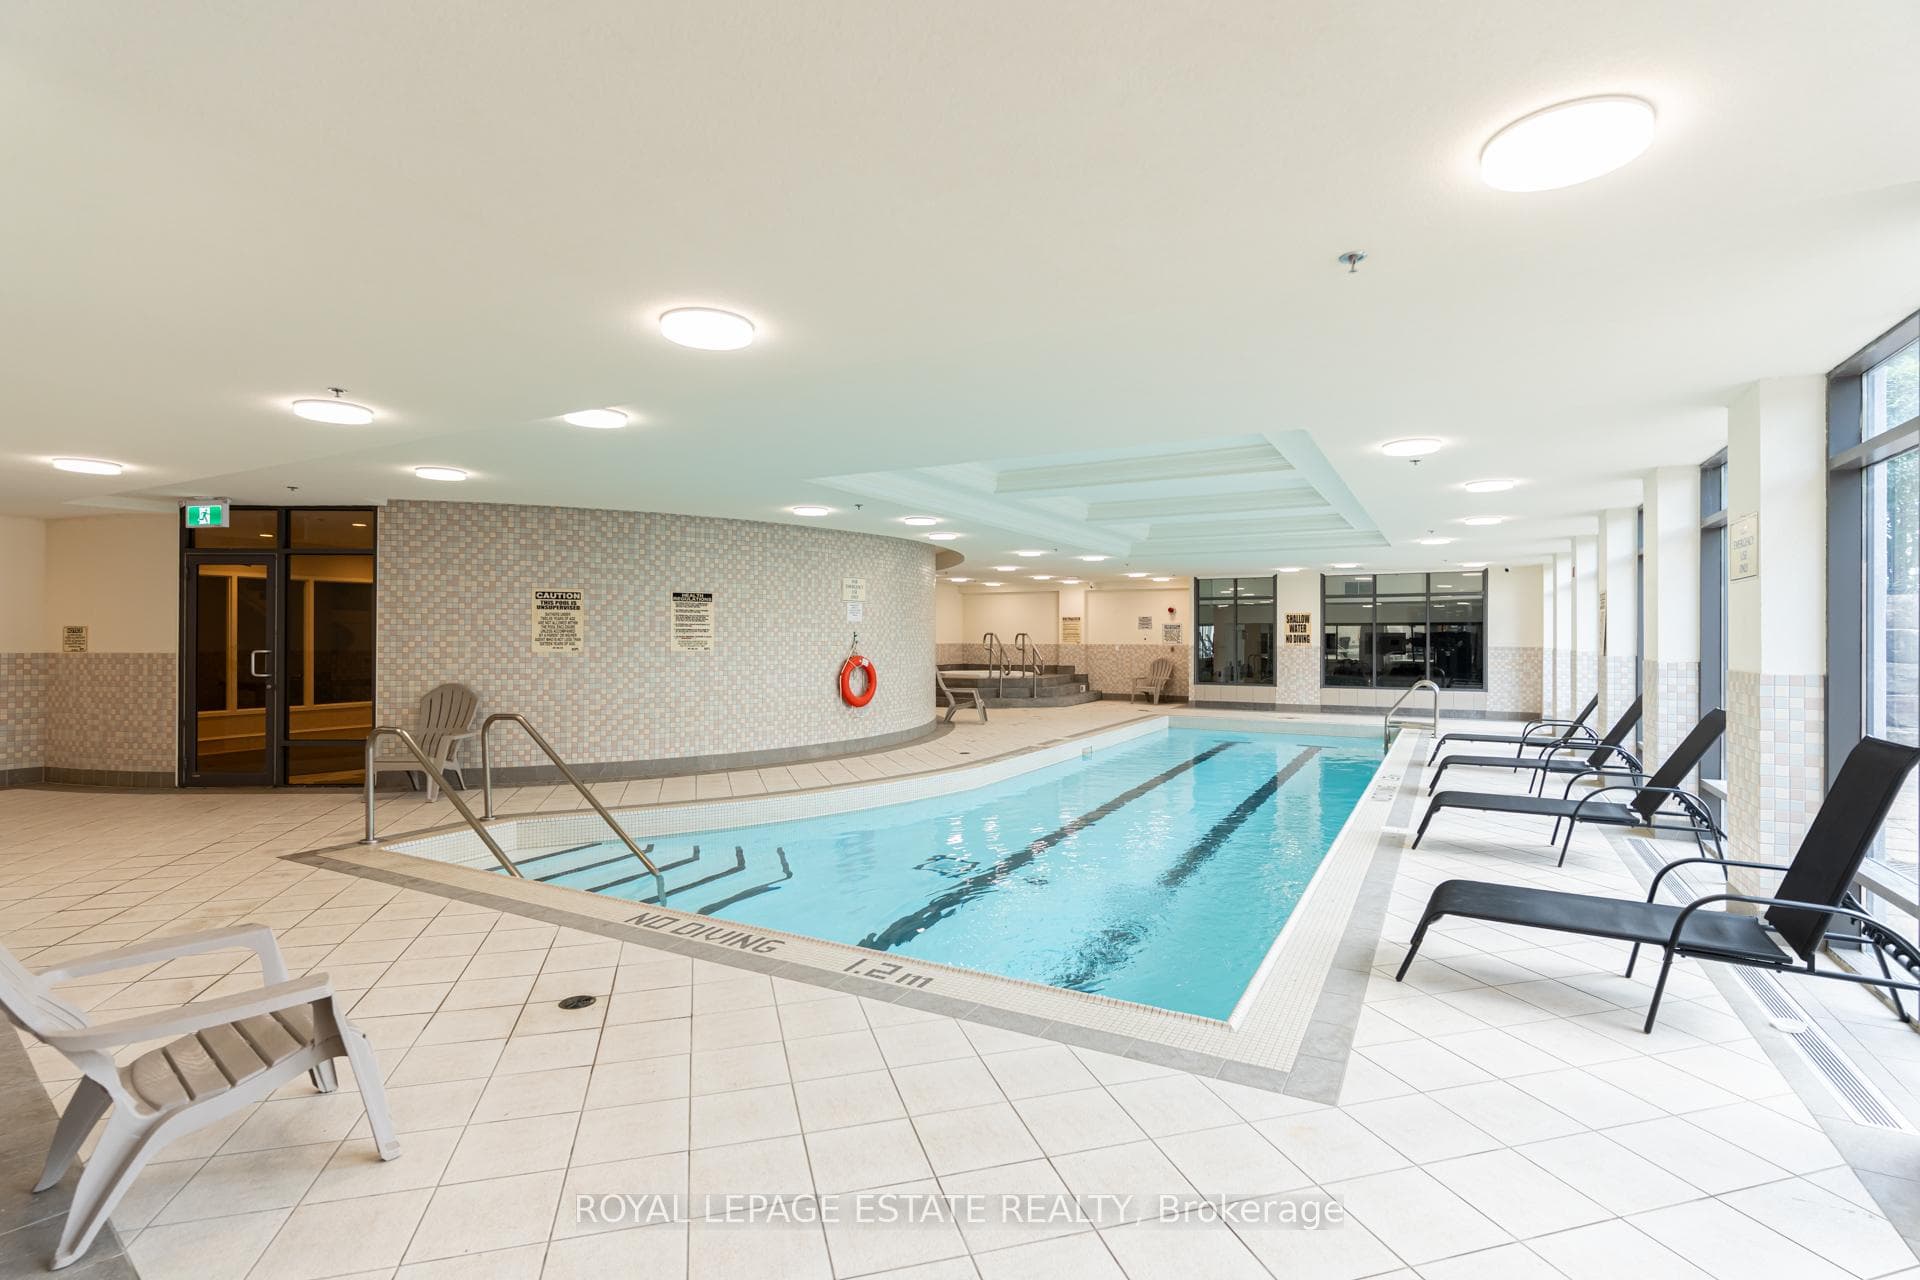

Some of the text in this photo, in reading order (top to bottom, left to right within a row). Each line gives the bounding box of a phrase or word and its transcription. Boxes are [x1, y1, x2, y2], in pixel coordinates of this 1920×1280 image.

[1286, 614, 1310, 623] SHALLOW
[1290, 624, 1306, 632] WATER
[1286, 635, 1310, 643] NO DIVING
[625, 912, 786, 953] NO DIVING
